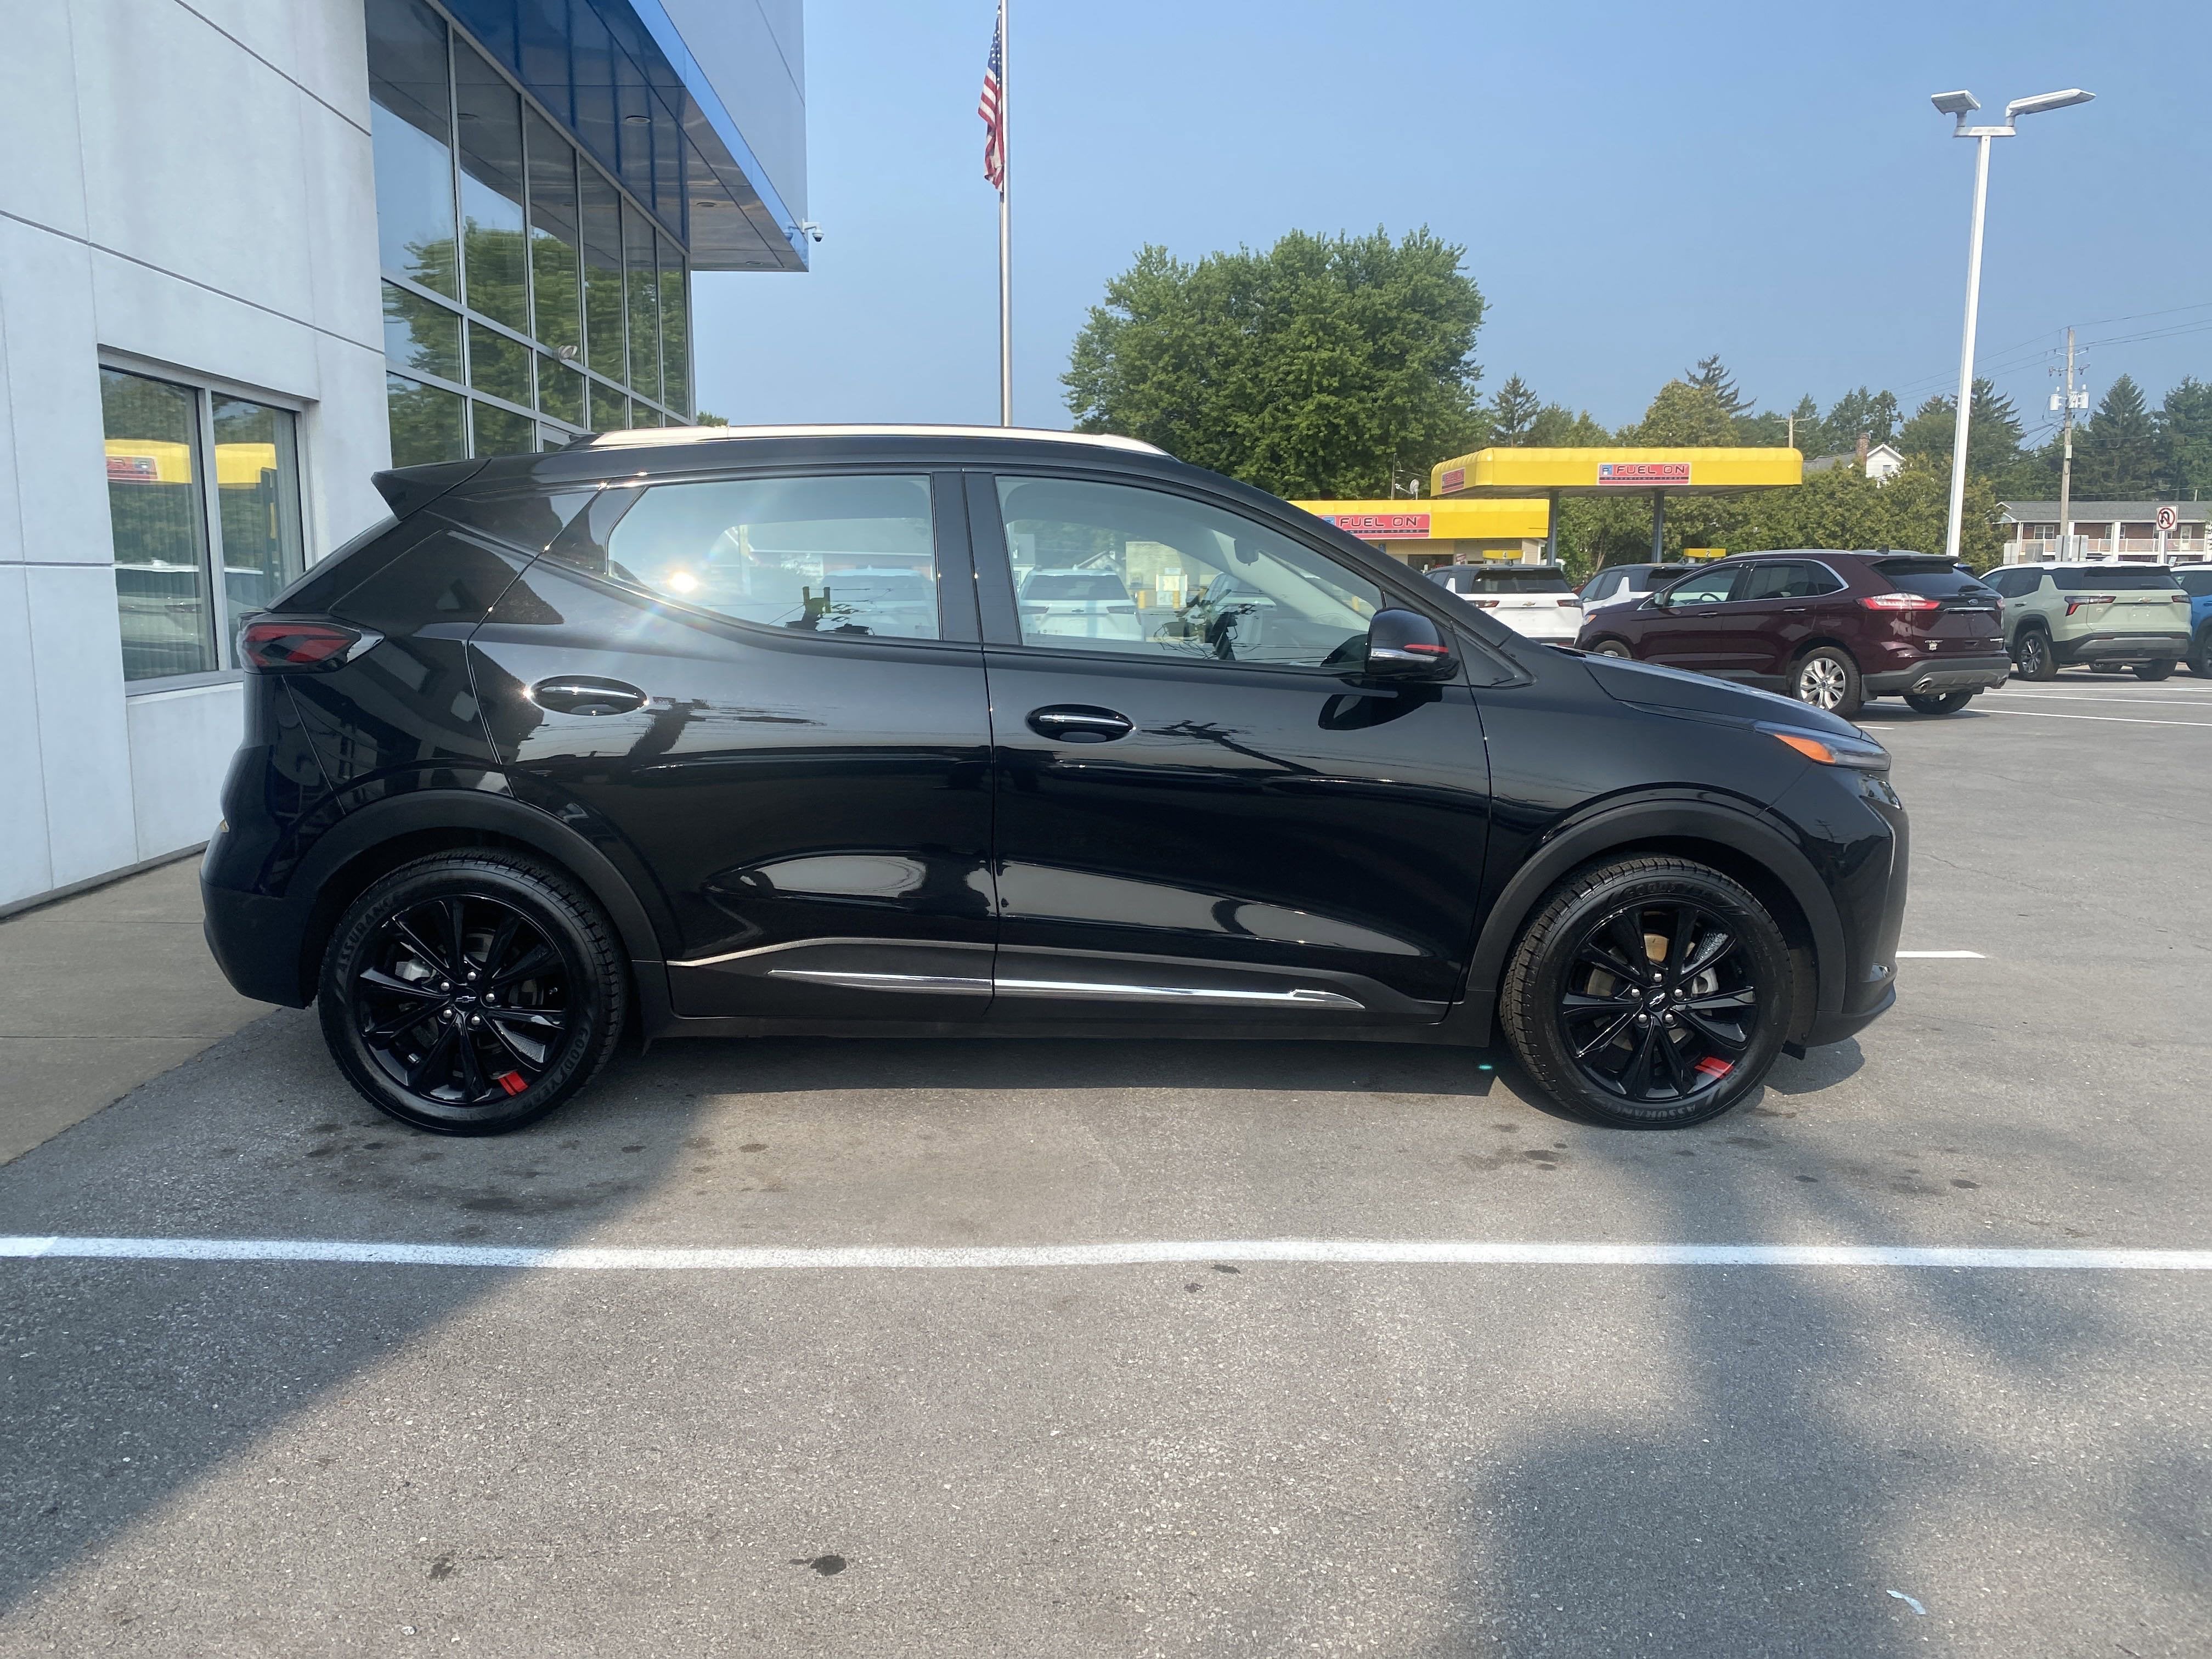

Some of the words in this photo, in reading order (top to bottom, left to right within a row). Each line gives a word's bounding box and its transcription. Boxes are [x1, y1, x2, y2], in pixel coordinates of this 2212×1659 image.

[1616, 465, 1656, 474] FUEL
[1663, 465, 1685, 474] ON
[1340, 517, 1384, 527] FUEL
[1392, 517, 1417, 526] ON
[336, 893, 397, 972] ASSURANC
